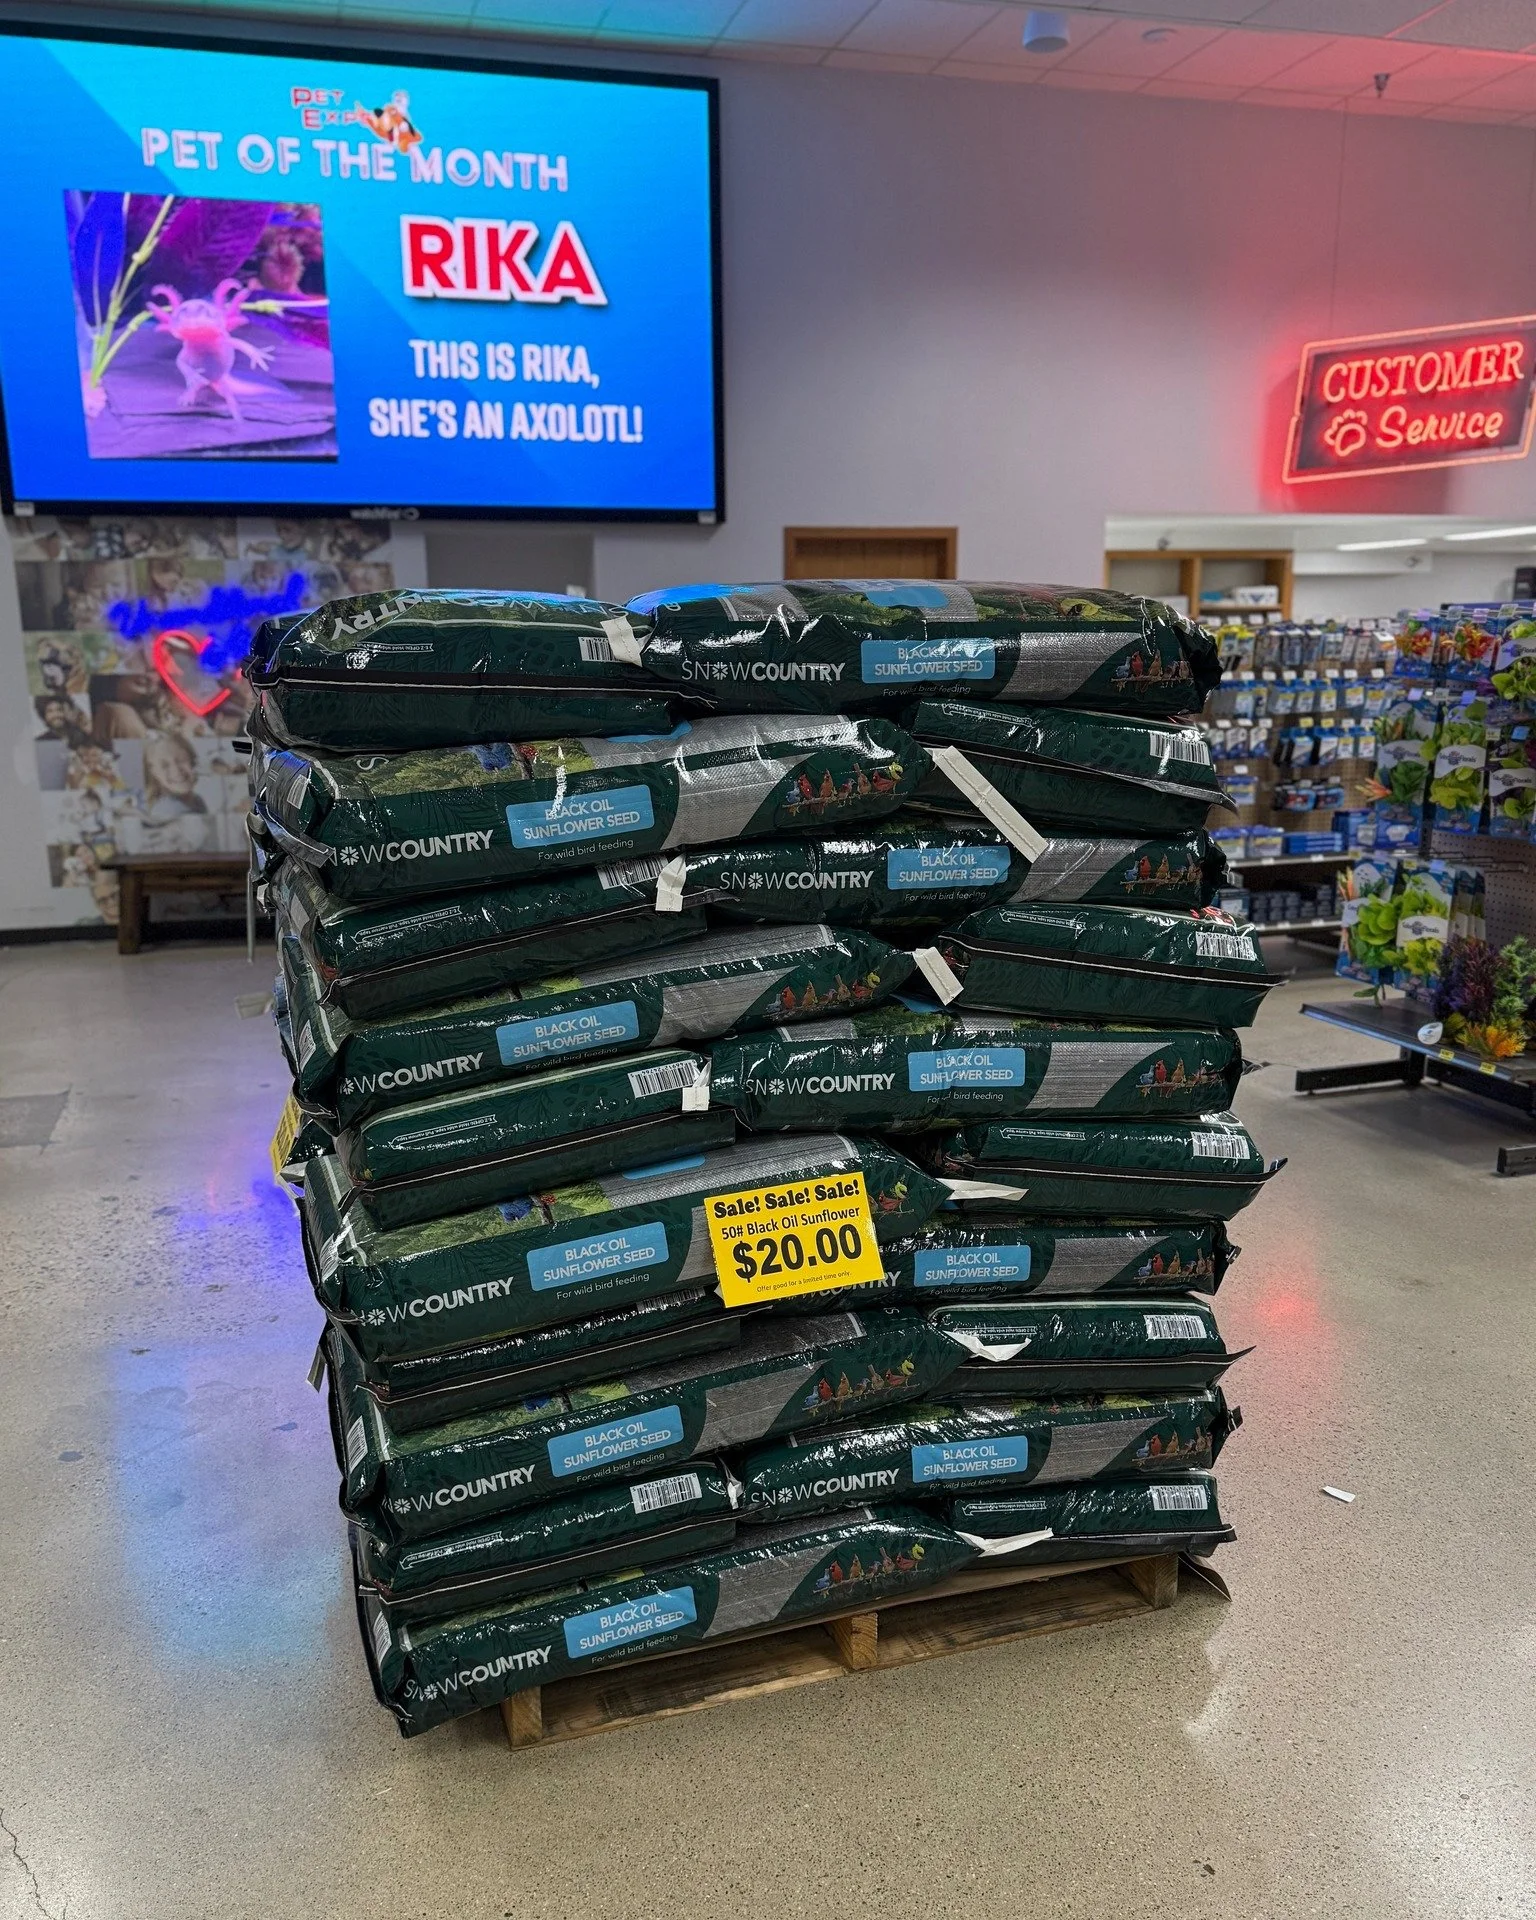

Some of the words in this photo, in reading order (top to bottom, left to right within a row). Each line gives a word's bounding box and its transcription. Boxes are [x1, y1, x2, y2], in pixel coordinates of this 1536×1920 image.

[292, 88, 343, 107] PET
[141, 128, 223, 171] PET
[237, 134, 301, 175] OF
[313, 139, 398, 181] THE
[410, 147, 568, 192] MONTH
[400, 214, 608, 305] RIKA
[409, 339, 479, 380] THIS
[486, 342, 516, 381] IS
[522, 343, 599, 389] RIKA,
[1323, 341, 1524, 403] CUSTOMER
[368, 398, 458, 438] SHE'S
[463, 400, 504, 440] AN
[510, 402, 643, 443] AXOLOTL!
[1376, 406, 1503, 448] Service
[898, 646, 934, 659] BLACK
[875, 662, 950, 676] SUNFLOWER
[952, 660, 982, 673] SEED
[883, 688, 898, 696] For
[591, 799, 614, 812] OIL
[523, 816, 604, 840] SUNFLOWER
[608, 812, 640, 827] SEED
[538, 850, 554, 861] For
[556, 846, 576, 859] wild
[577, 843, 595, 855] bird
[598, 838, 633, 854] feeding
[921, 854, 957, 867] BLACK
[960, 854, 977, 865] OIL
[899, 869, 967, 883] SUNFLOWER
[970, 868, 999, 880] SEED
[905, 893, 918, 902] For
[920, 893, 936, 901] wild
[938, 892, 954, 901] bird
[535, 1019, 575, 1038] BLACK
[579, 1014, 601, 1027] OIL
[513, 1033, 591, 1058] SUNFLOWER
[594, 1026, 626, 1041] SEED
[525, 1062, 539, 1071] For
[541, 1058, 561, 1069] wild
[563, 1054, 581, 1065] bird
[583, 1047, 618, 1060] feeding
[937, 1056, 972, 1068] BLACK
[975, 1055, 993, 1066] OIL
[921, 1071, 982, 1084] SUNFLOWER
[985, 1070, 1013, 1081] SEED
[954, 1092, 970, 1100] bird
[973, 1092, 1004, 1101] feeding
[714, 1196, 760, 1218] Sale!
[765, 1188, 810, 1210] Sale!
[815, 1179, 860, 1201] Sale!
[722, 1225, 744, 1240] 50#
[748, 1219, 778, 1236] Black
[782, 1215, 799, 1229] Oil
[802, 1207, 860, 1225] Sunflower
[564, 1244, 606, 1262] BLACK
[609, 1237, 630, 1250] OIL
[733, 1224, 862, 1283] $20.00
[947, 1254, 980, 1265] BLACK
[983, 1253, 1000, 1263] OIL
[544, 1255, 622, 1281] SUNFLOWER
[624, 1247, 655, 1263] SEED
[926, 1268, 991, 1280] SUNFLOWER
[993, 1266, 1019, 1277] SEED
[556, 1290, 572, 1300] For
[574, 1285, 594, 1297] wild
[596, 1281, 613, 1292] bird
[615, 1272, 650, 1289] feeding
[774, 1282, 787, 1290] good
[803, 1275, 822, 1284] limited
[585, 1427, 625, 1447] BLACK
[628, 1421, 647, 1436] OIL
[564, 1440, 639, 1468] SUNFLOWER
[641, 1430, 671, 1446] SEED
[943, 1447, 978, 1460] BLACK
[980, 1446, 998, 1457] OIL
[576, 1474, 591, 1482] For
[593, 1468, 612, 1480] wild
[614, 1463, 630, 1474] bird
[632, 1453, 665, 1469] feeding
[924, 1459, 989, 1476] SUNFLOWER
[991, 1457, 1017, 1469] SEED
[961, 1480, 975, 1488] bird
[977, 1477, 1007, 1488] feeding
[600, 1607, 639, 1629] BLACK
[641, 1601, 661, 1616] OIL
[579, 1623, 653, 1650] SUNFLOWER
[656, 1611, 684, 1627] SEED
[592, 1653, 606, 1663] For
[608, 1648, 625, 1660] wild
[628, 1642, 644, 1655] bird
[646, 1633, 678, 1650] feeding
